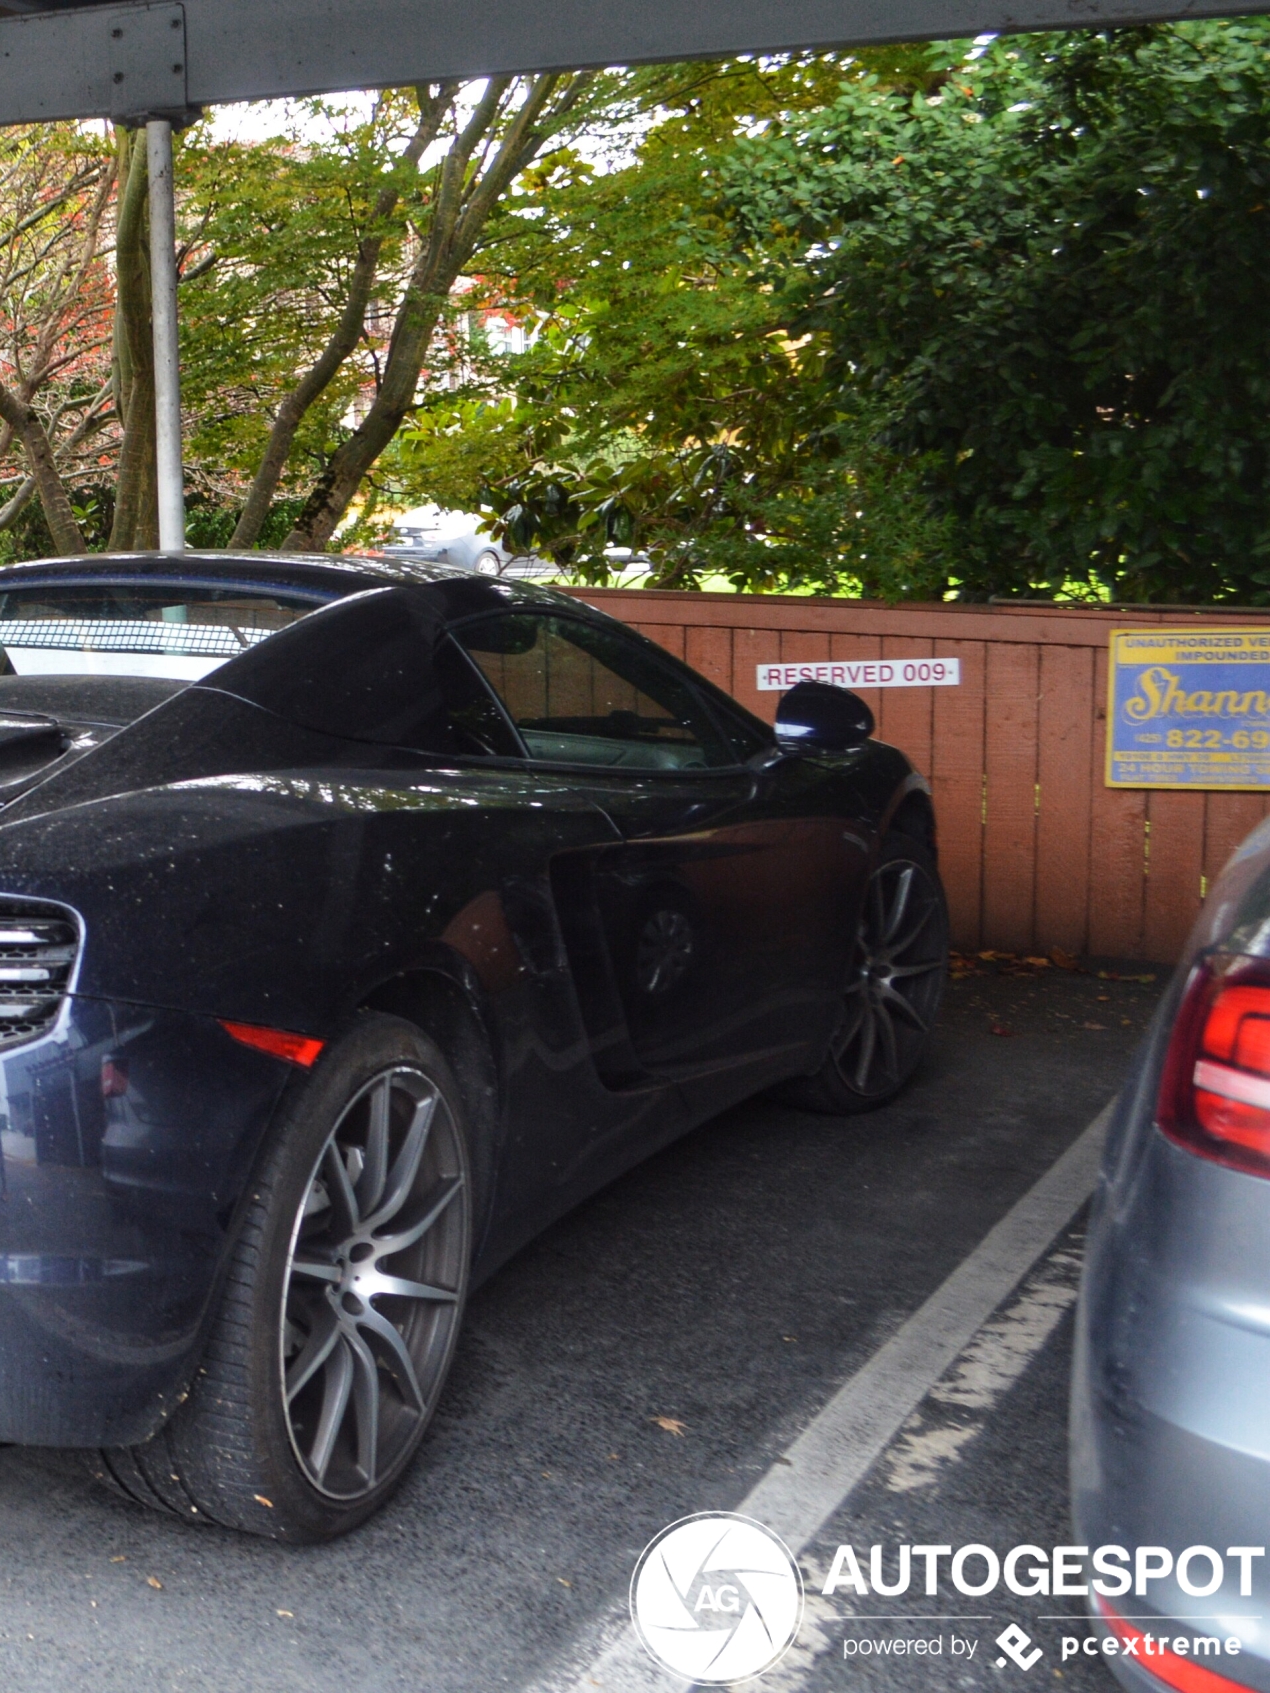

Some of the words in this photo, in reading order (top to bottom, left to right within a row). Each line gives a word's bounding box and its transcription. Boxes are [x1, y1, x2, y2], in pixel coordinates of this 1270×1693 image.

[1126, 637, 1243, 648] UNAUTHORIZED
[1248, 637, 1270, 647] VE
[1175, 650, 1270, 661] IMPOUNDED
[767, 664, 894, 685] RESERVED
[903, 663, 946, 682] 009
[1124, 666, 1270, 720] Shann
[1118, 763, 1137, 773] 24
